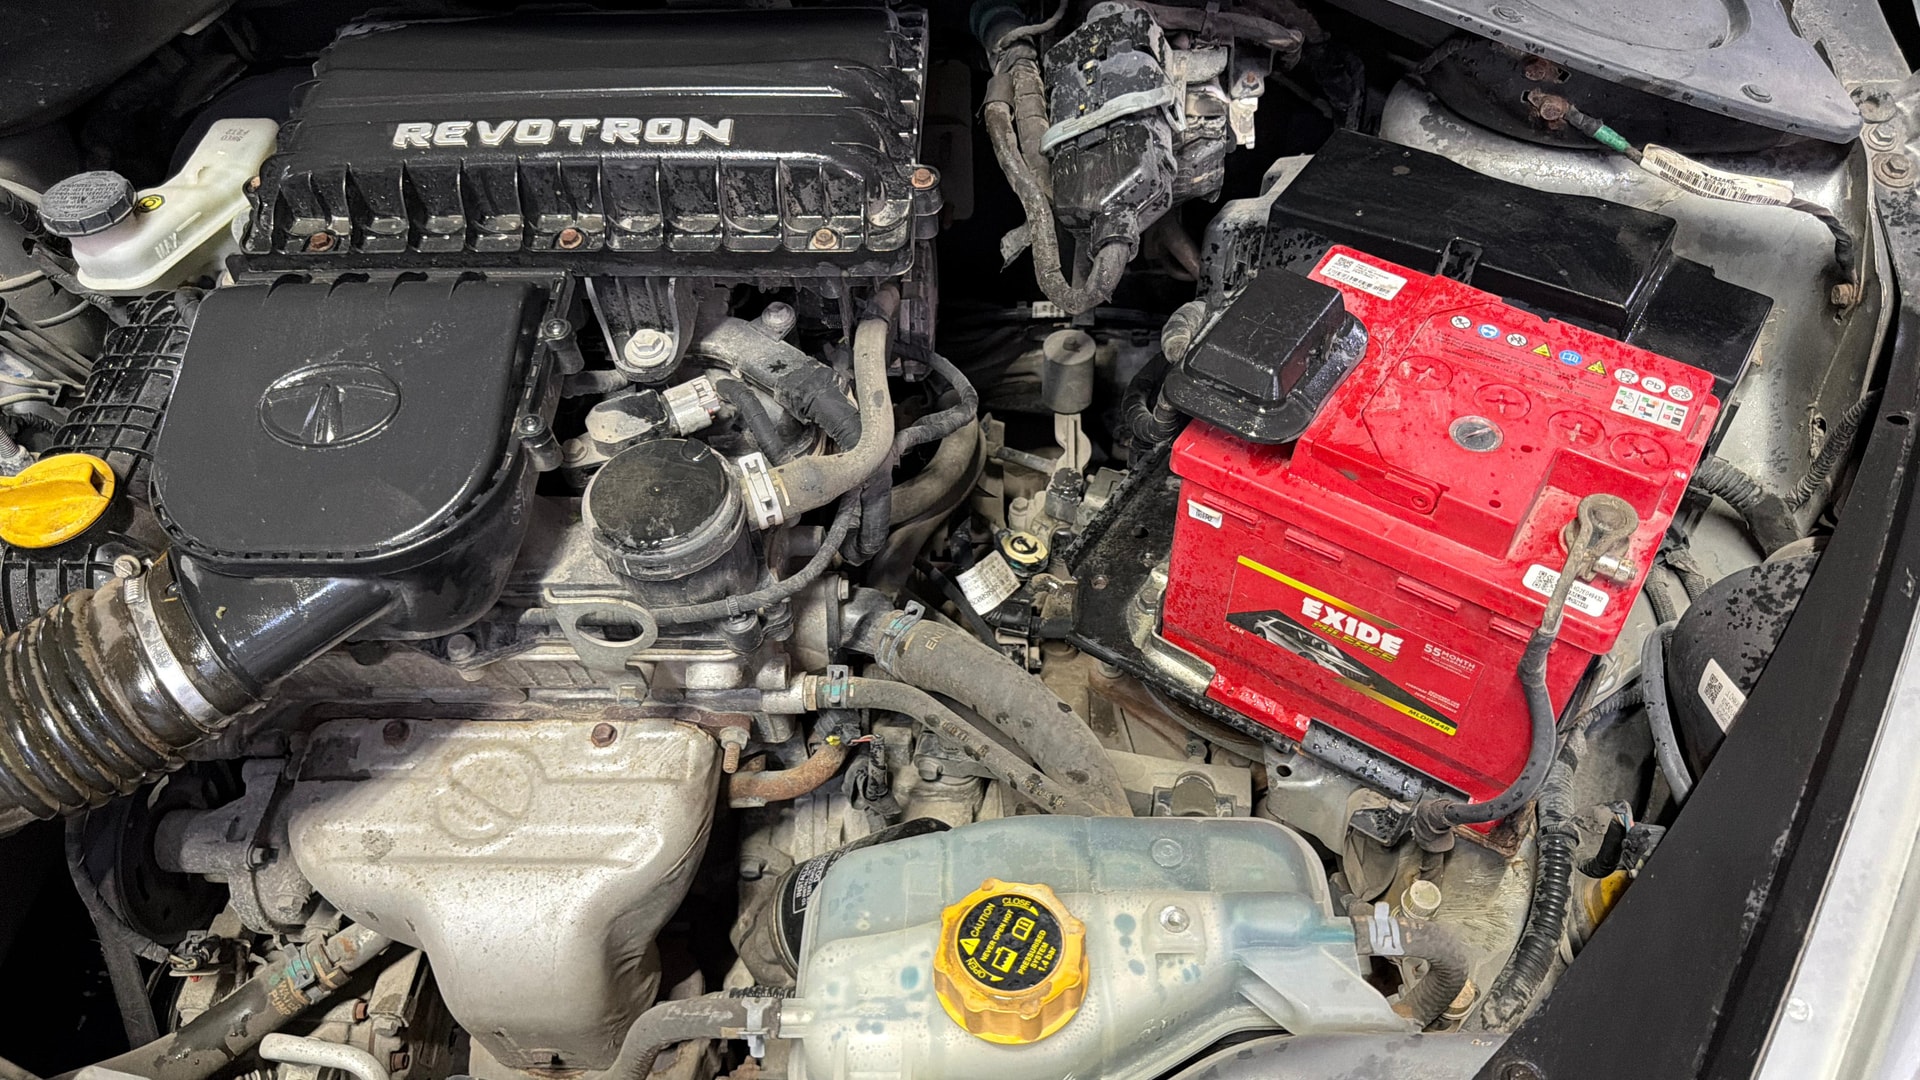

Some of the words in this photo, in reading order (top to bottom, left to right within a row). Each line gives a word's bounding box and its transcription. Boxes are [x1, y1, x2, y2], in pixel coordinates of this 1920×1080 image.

[392, 117, 735, 147] REVOTRON
[1645, 379, 1662, 390] Pb
[1229, 624, 1245, 636] CAR
[1301, 596, 1404, 656] EXIDE
[1311, 621, 1398, 663] MILEAGE
[1423, 643, 1442, 657] 55
[1441, 650, 1476, 670] MONTH
[1408, 709, 1450, 732] MLDIN44R
[1002, 897, 1032, 908] CLOSE
[970, 902, 996, 938] CAUTION
[980, 940, 997, 962] NEVER
[993, 922, 1007, 941] OPEN
[1003, 909, 1014, 925] HOT
[1017, 929, 1047, 975] PRESSURISED
[1030, 941, 1049, 969] SYSTEM
[1038, 960, 1050, 972] 1.4
[1045, 946, 1057, 961] bar
[966, 957, 987, 979] OPEN
